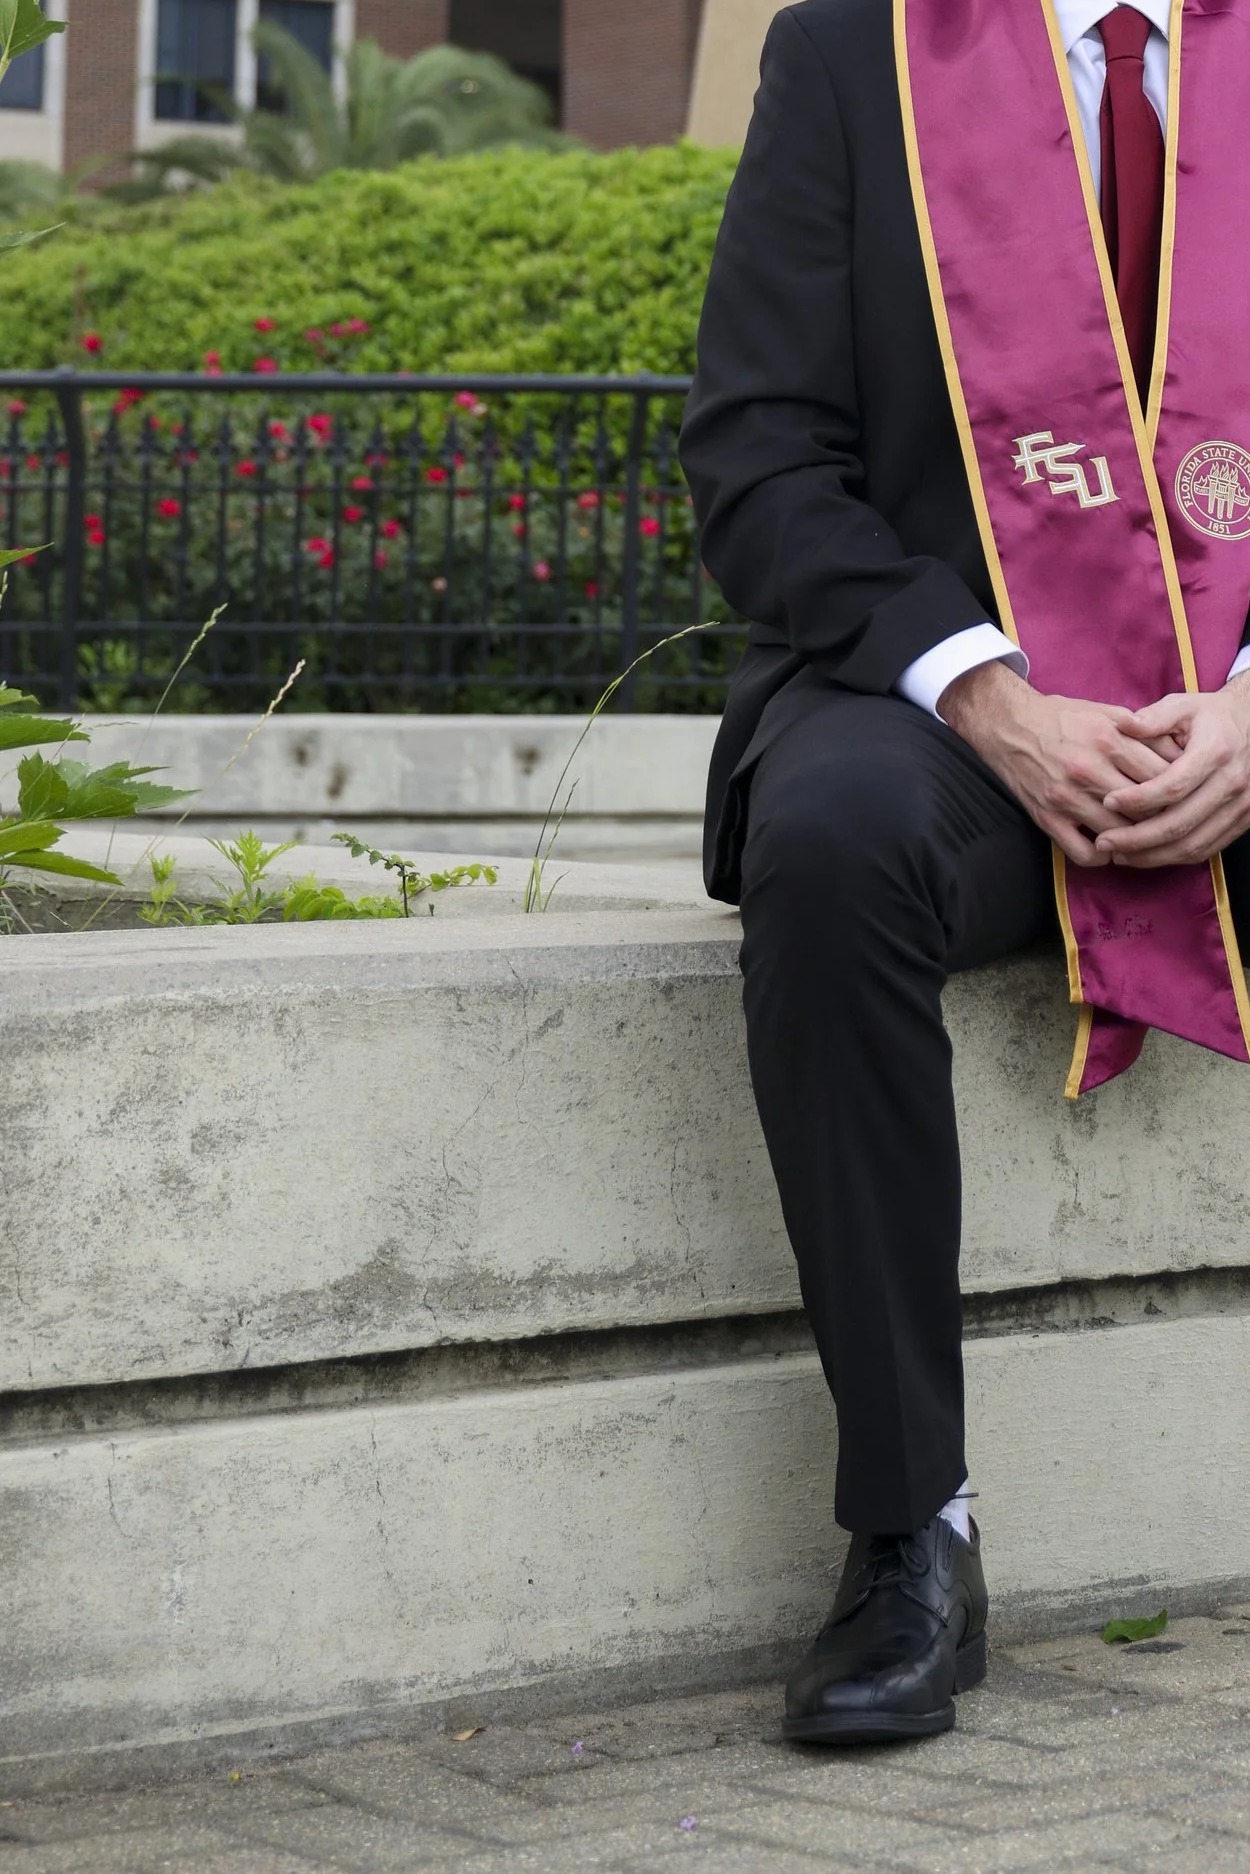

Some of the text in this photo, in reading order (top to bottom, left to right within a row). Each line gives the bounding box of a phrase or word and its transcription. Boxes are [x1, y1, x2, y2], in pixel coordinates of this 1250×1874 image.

[1011, 431, 1121, 509] FSU
[1181, 456, 1202, 508] FLORIDA
[1202, 447, 1236, 460] STATE
[1207, 520, 1231, 535] 1851
